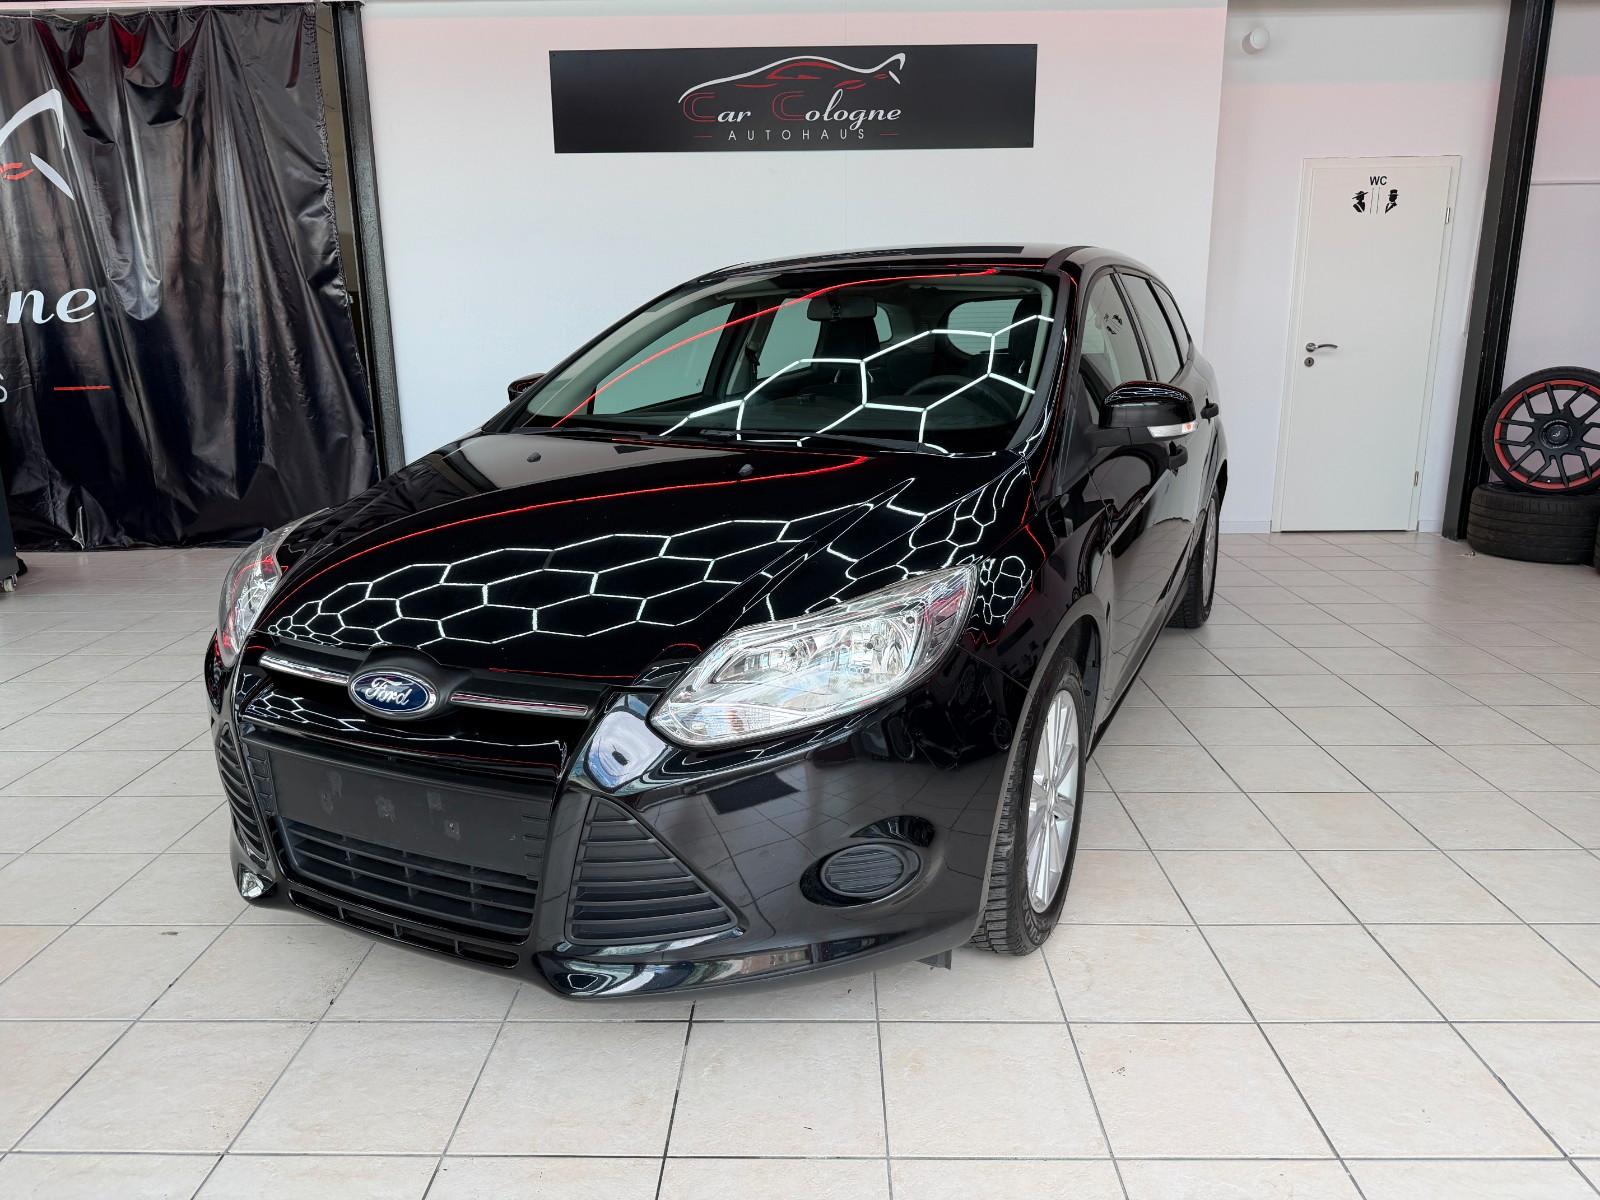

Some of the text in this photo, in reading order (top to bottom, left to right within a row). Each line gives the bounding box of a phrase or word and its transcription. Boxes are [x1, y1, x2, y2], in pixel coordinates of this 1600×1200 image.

[683, 88, 902, 131] Car Cologne
[727, 128, 865, 141] AUTOHAUS
[1369, 175, 1387, 186] WC
[0, 288, 97, 325] ne
[364, 677, 416, 706] Ford
